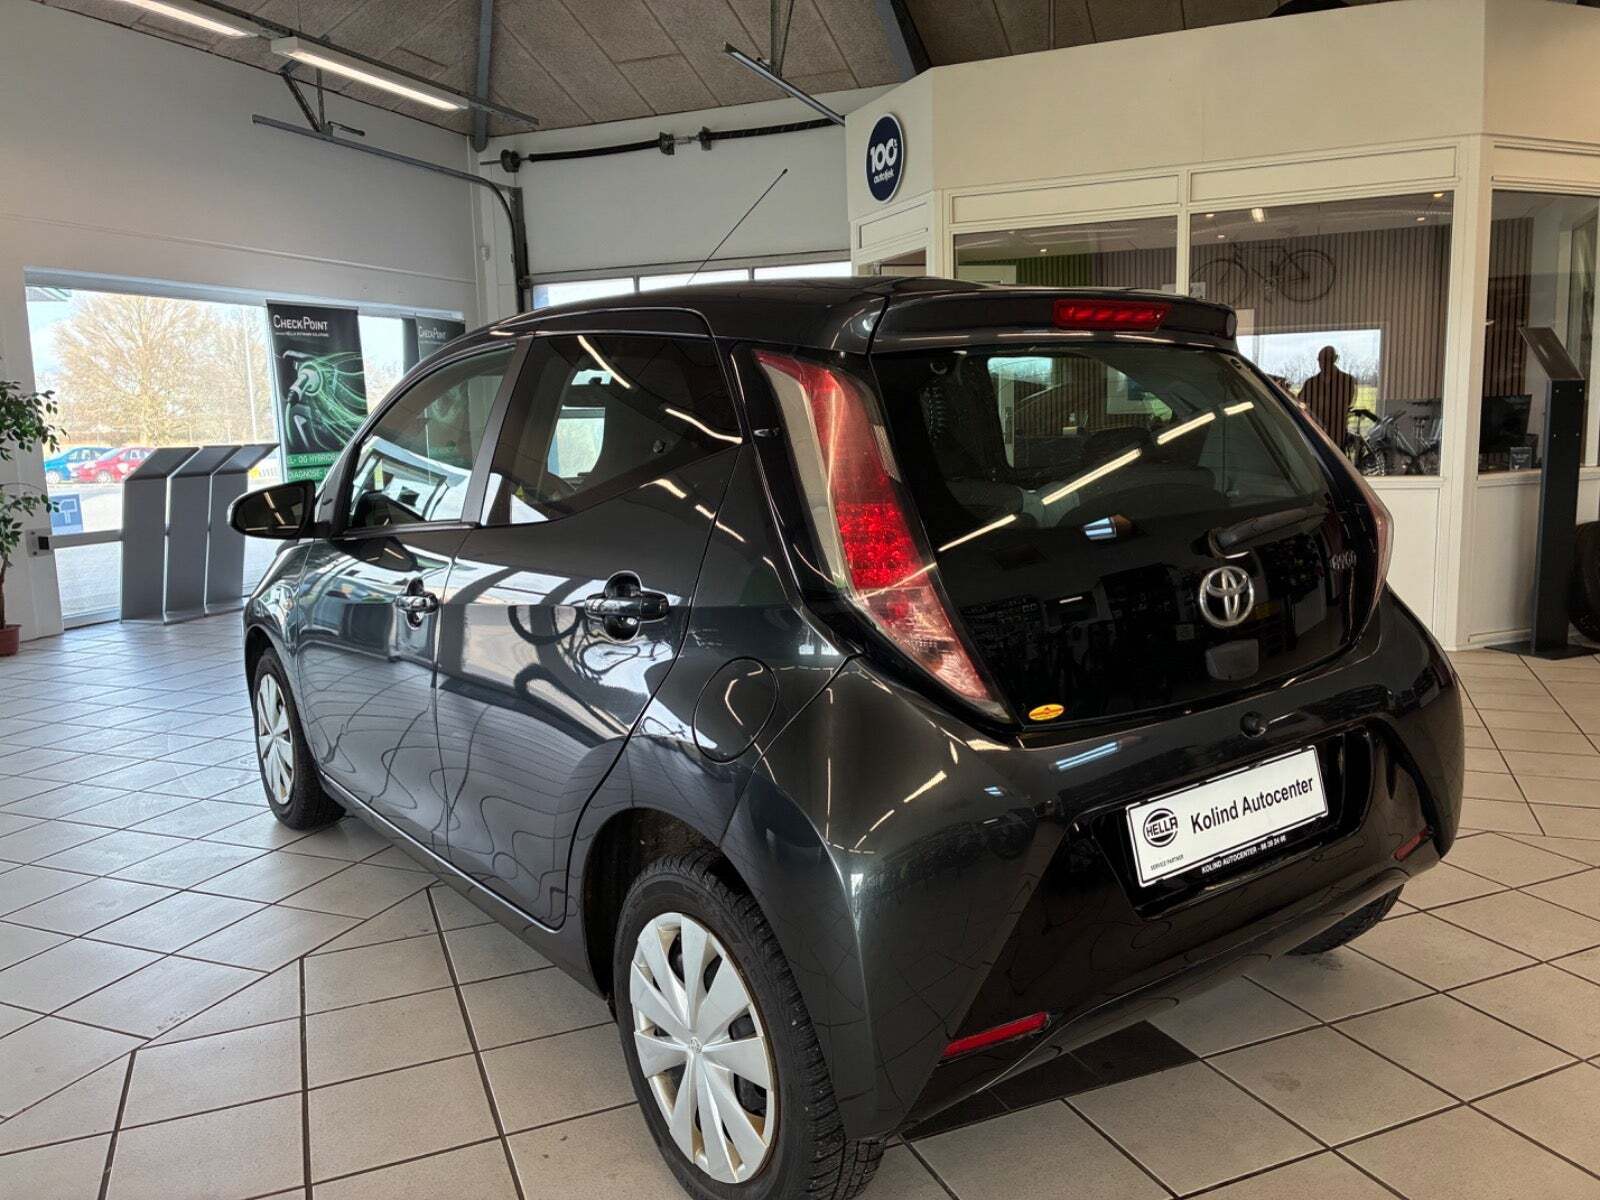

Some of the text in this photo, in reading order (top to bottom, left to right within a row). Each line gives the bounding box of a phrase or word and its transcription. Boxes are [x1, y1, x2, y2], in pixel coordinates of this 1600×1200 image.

[1190, 778, 1313, 834] Kolind Autocenter
[1145, 816, 1178, 837] HELLA
[1201, 861, 1222, 874] KOLIND
[1223, 846, 1257, 866] AUTOCENTER
